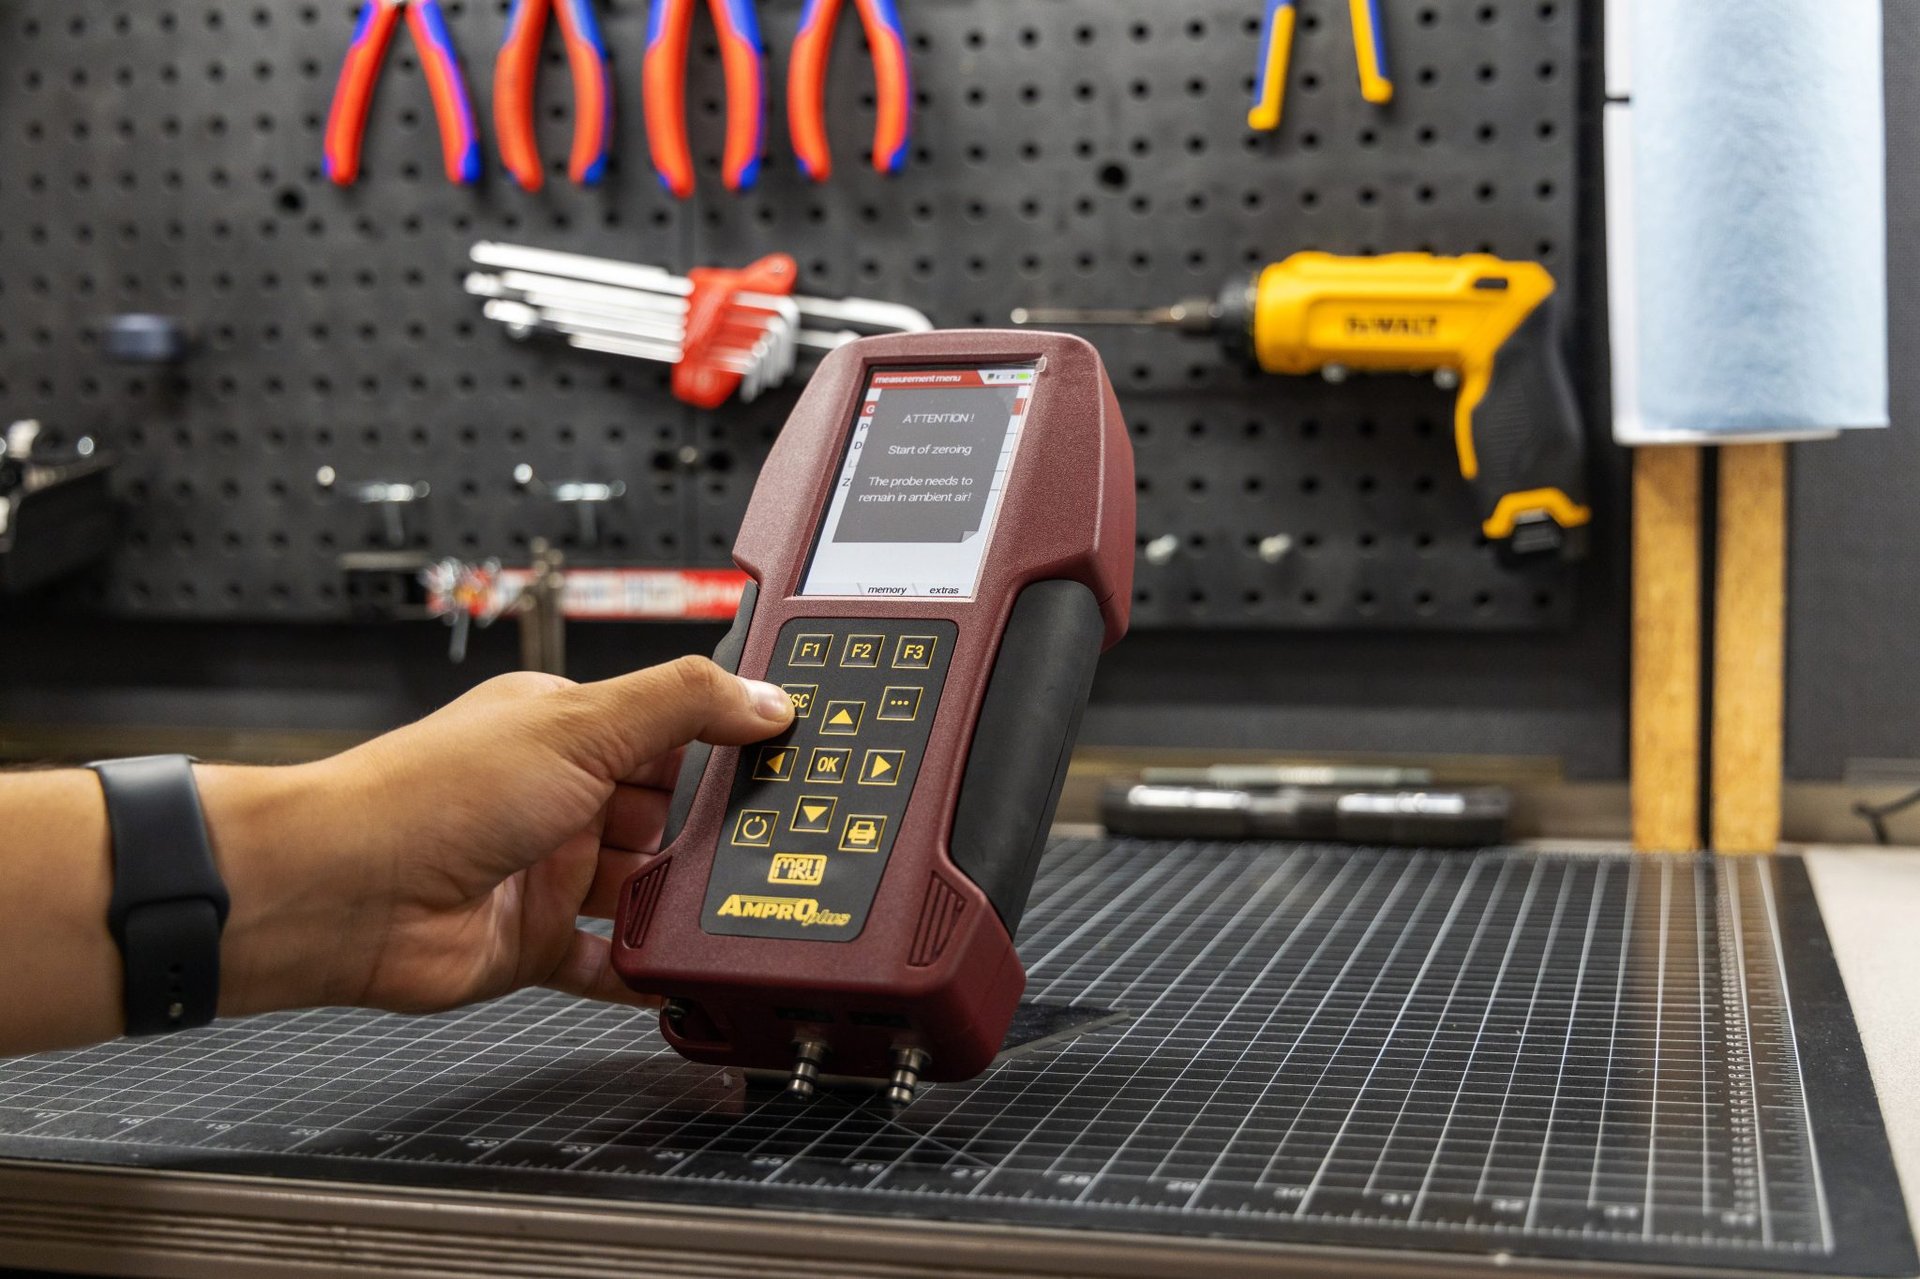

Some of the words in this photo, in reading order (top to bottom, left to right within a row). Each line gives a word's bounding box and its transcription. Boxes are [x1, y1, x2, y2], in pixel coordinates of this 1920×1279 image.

[874, 374, 935, 384] measurement
[935, 373, 962, 383] menu
[887, 444, 916, 455] Start
[916, 444, 932, 455] of
[931, 444, 974, 457] zeroing
[869, 475, 890, 486] The
[889, 475, 923, 488] probe
[924, 475, 959, 486] needs
[961, 475, 974, 486] to
[858, 491, 896, 502] remain
[897, 491, 907, 502] in
[908, 491, 952, 502] ambient
[954, 491, 973, 502] air!
[867, 586, 907, 596] memory
[929, 585, 960, 595] extras
[801, 642, 821, 657] F1
[851, 643, 872, 658] F2
[903, 644, 925, 660] F3
[788, 693, 810, 709] SC
[817, 755, 840, 773] OK
[773, 856, 822, 881] MRU
[34, 1111, 60, 1119] 17
[119, 1117, 144, 1125] 18
[205, 1123, 232, 1131] 19
[376, 1133, 404, 1141] 21
[466, 1139, 501, 1148] 22
[559, 1145, 593, 1154] 23
